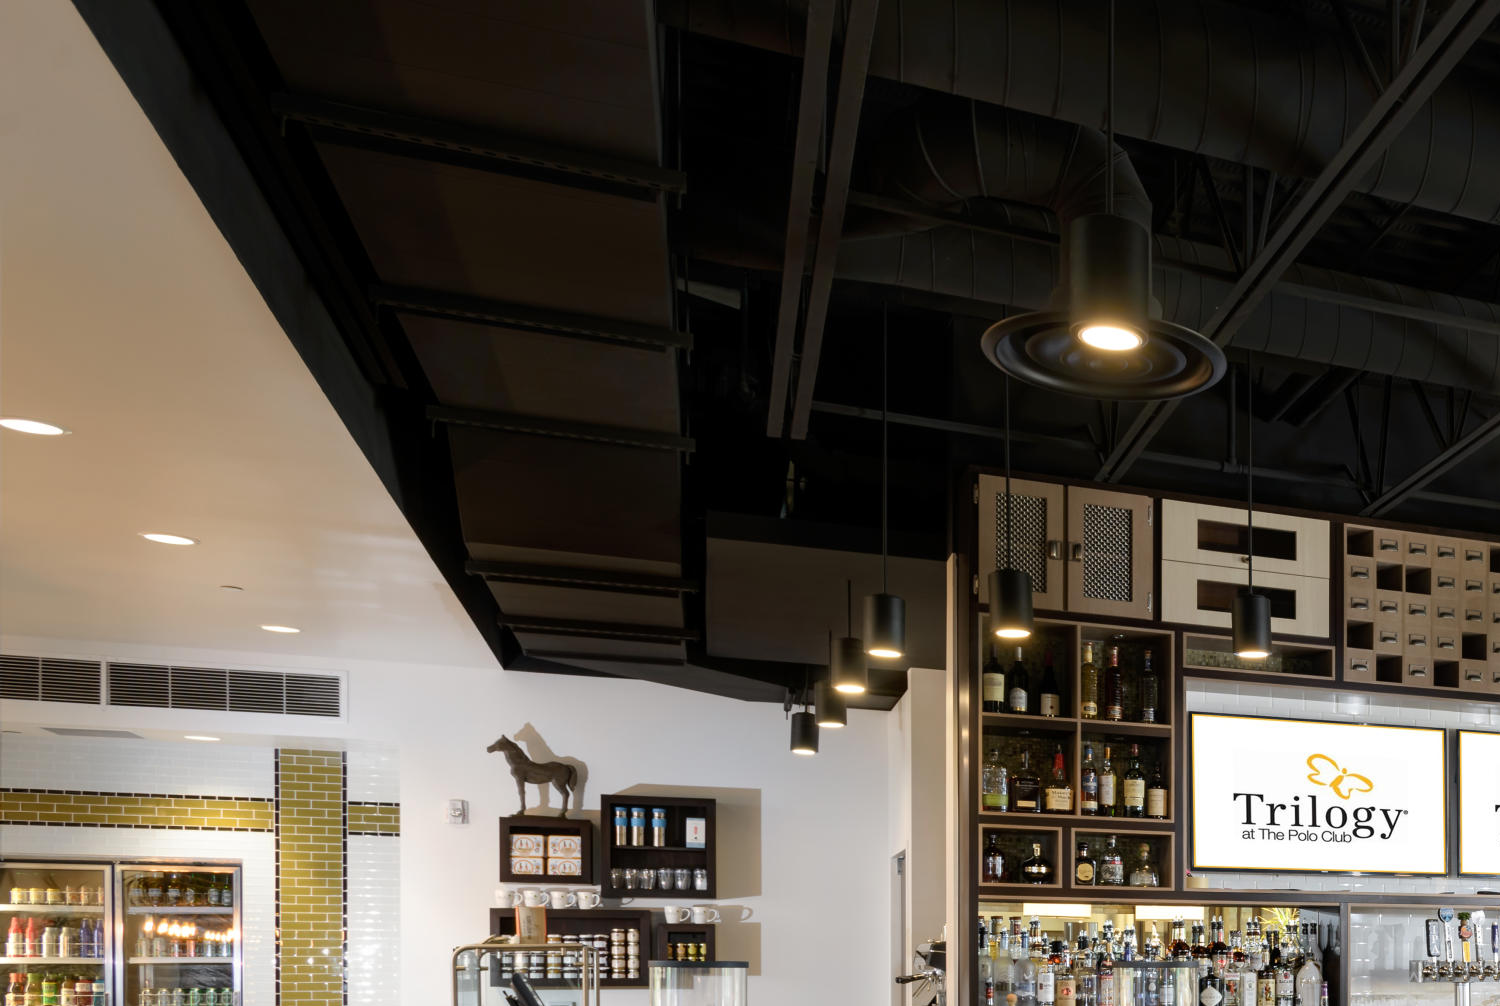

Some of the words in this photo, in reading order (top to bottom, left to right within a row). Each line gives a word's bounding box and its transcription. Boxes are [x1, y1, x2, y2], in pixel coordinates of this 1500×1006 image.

[1233, 792, 1403, 840] Trilogy
[1241, 829, 1255, 840] at
[1258, 828, 1285, 841] The
[1288, 829, 1318, 842] Polo
[1321, 830, 1352, 843] Club
